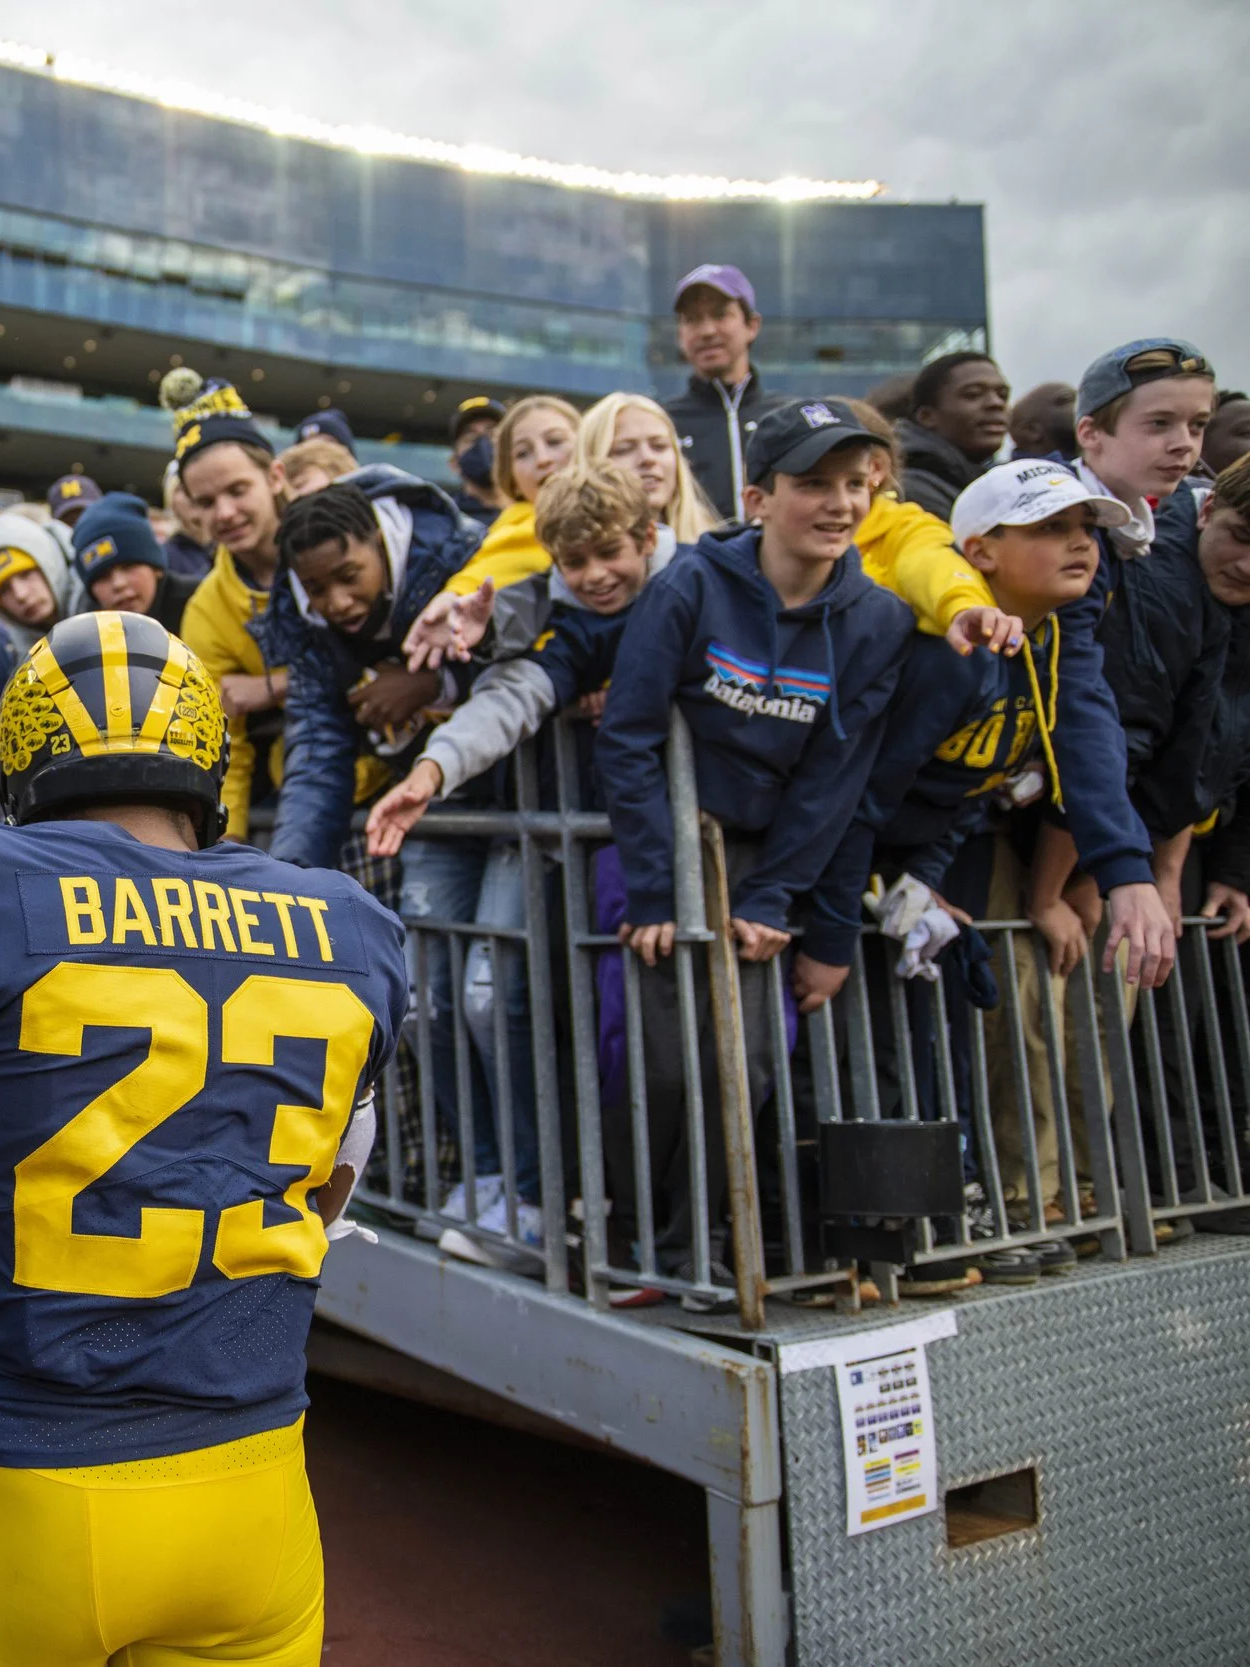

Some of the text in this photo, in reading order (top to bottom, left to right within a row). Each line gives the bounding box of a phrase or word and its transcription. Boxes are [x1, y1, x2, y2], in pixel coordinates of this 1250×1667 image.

[50, 733, 71, 755] 23
[58, 876, 334, 962] BARRETT
[13, 961, 375, 1299] 23
